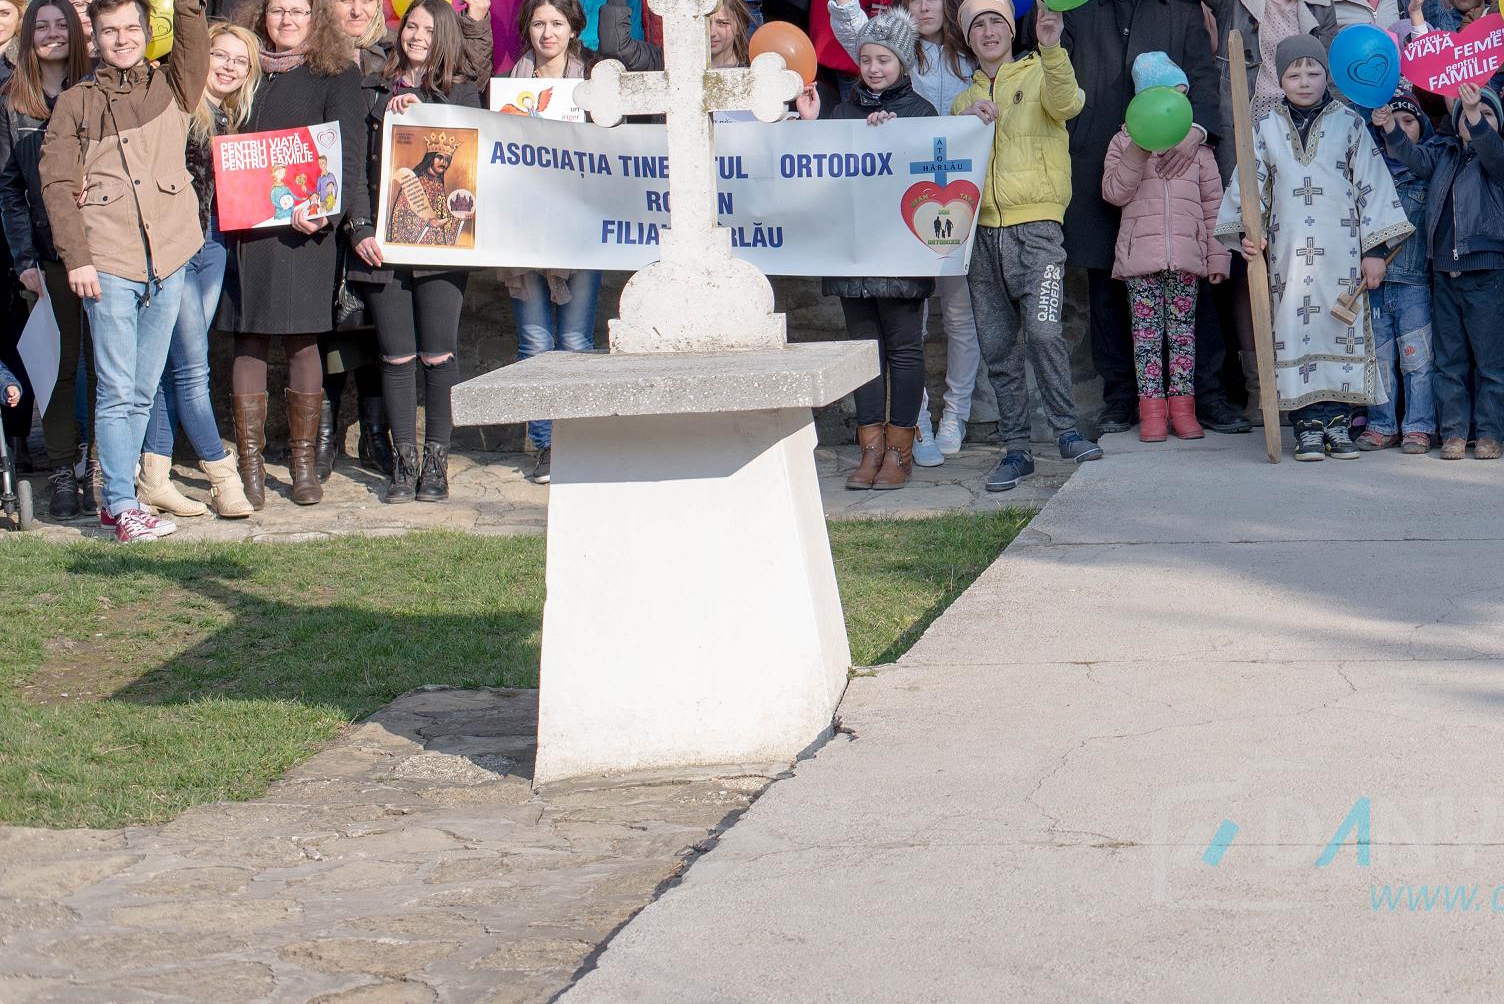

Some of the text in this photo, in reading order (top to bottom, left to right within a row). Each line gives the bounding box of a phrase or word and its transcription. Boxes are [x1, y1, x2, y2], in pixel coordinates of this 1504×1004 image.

[1404, 32, 1455, 62] VIAȚĂ
[1408, 34, 1440, 50] pentru
[1429, 56, 1499, 91] FAMILIE
[1446, 56, 1478, 73] pentru
[222, 156, 268, 171] PENTRU
[490, 141, 612, 179] ASOCIAȚIA
[780, 151, 894, 180] ORTODOX
